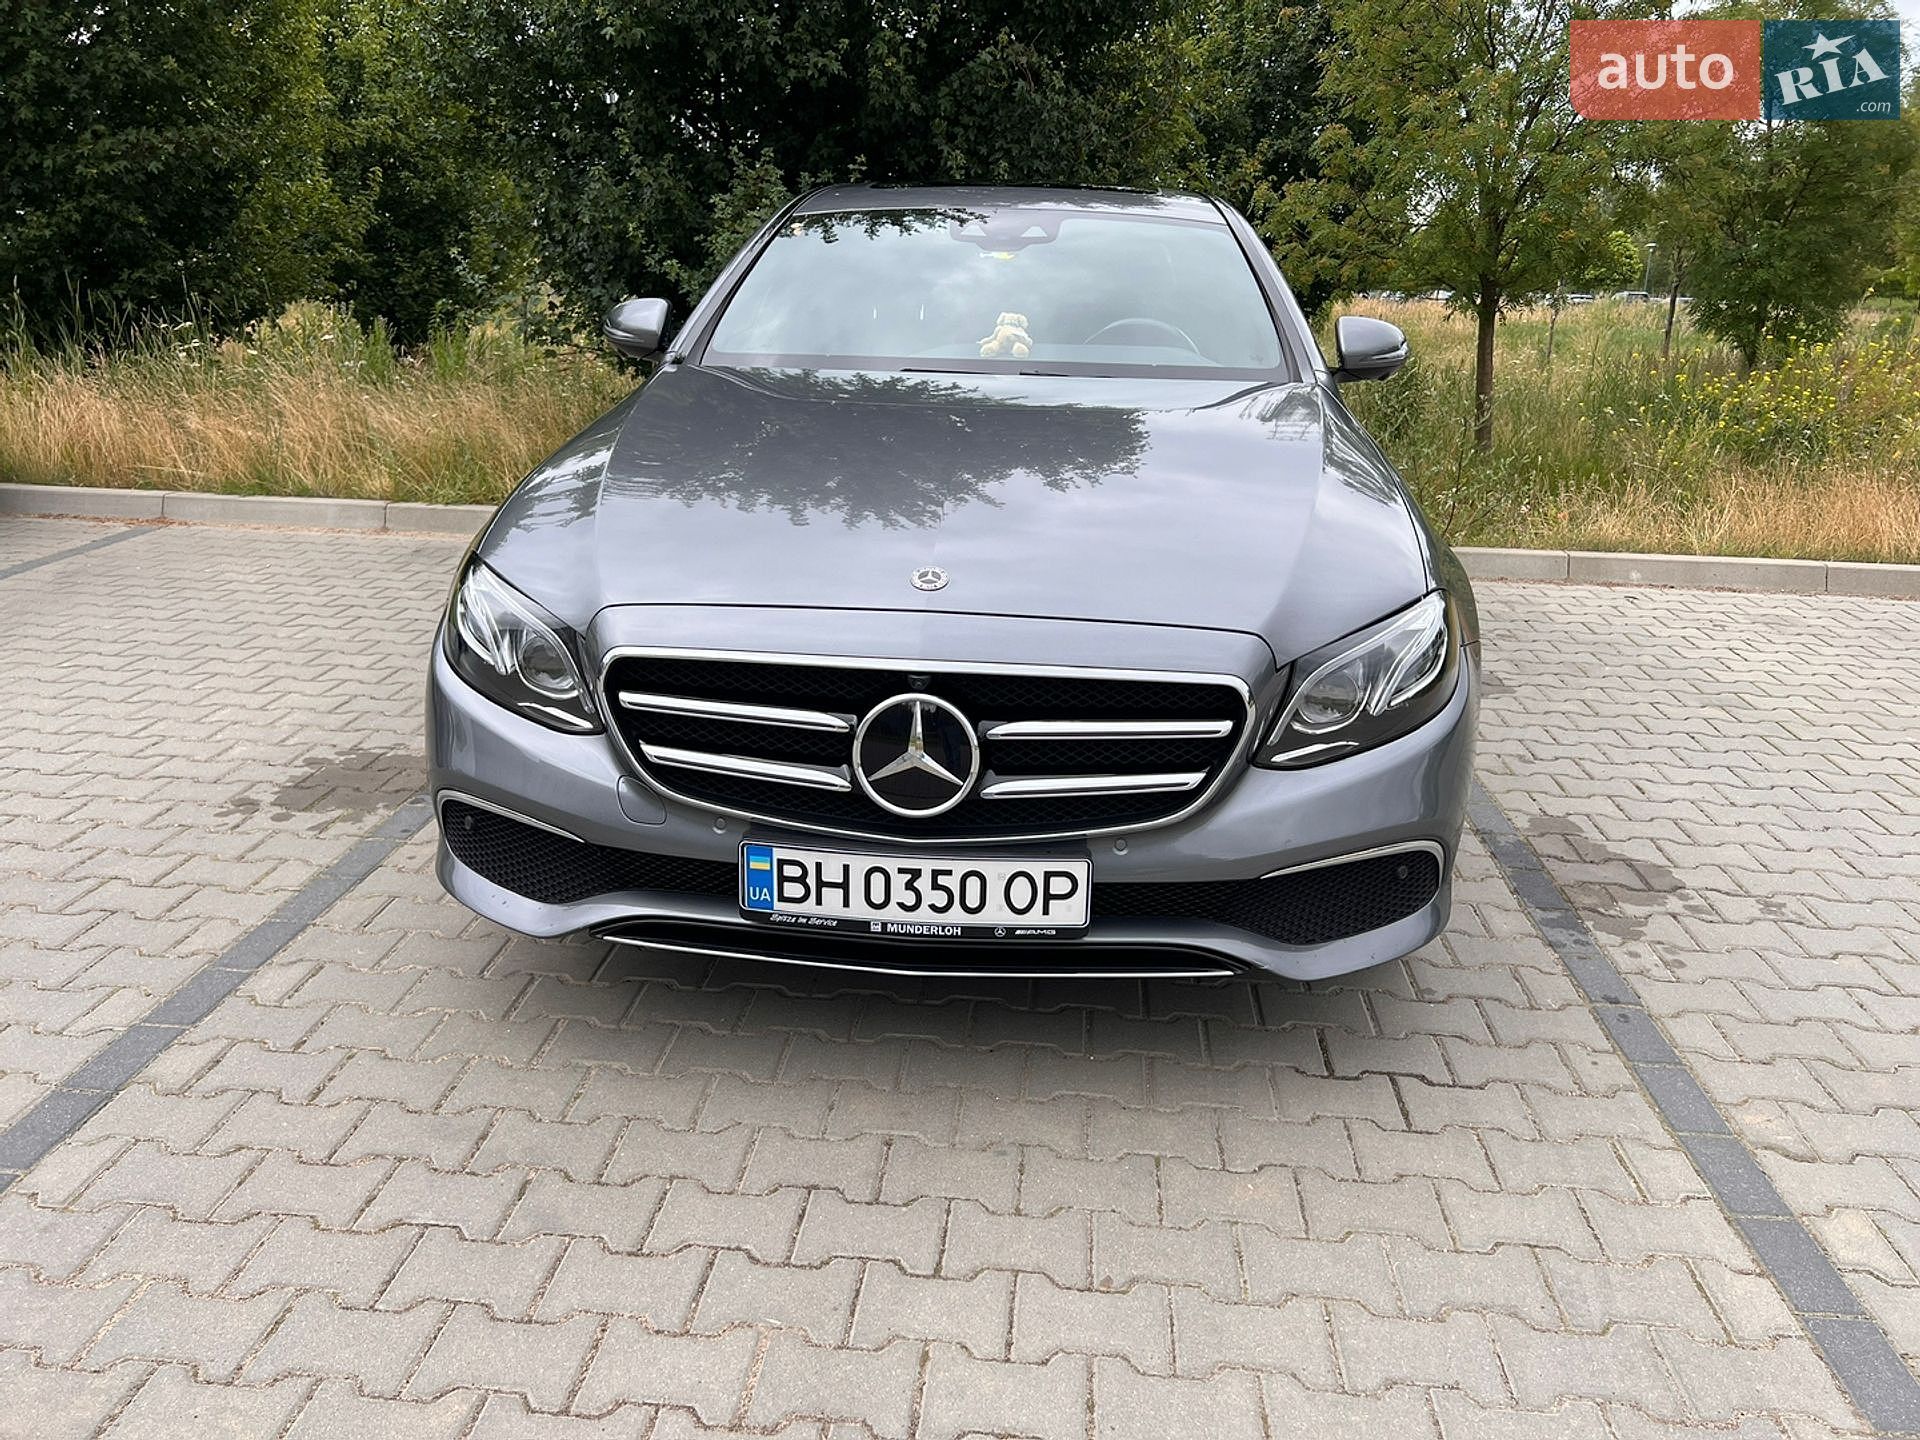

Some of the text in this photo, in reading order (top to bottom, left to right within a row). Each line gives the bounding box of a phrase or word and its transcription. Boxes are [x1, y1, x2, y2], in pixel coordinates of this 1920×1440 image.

[749, 887, 771, 901] UA
[776, 858, 1079, 916] BH 0350 OP
[887, 923, 961, 936] MUNDERLOH
